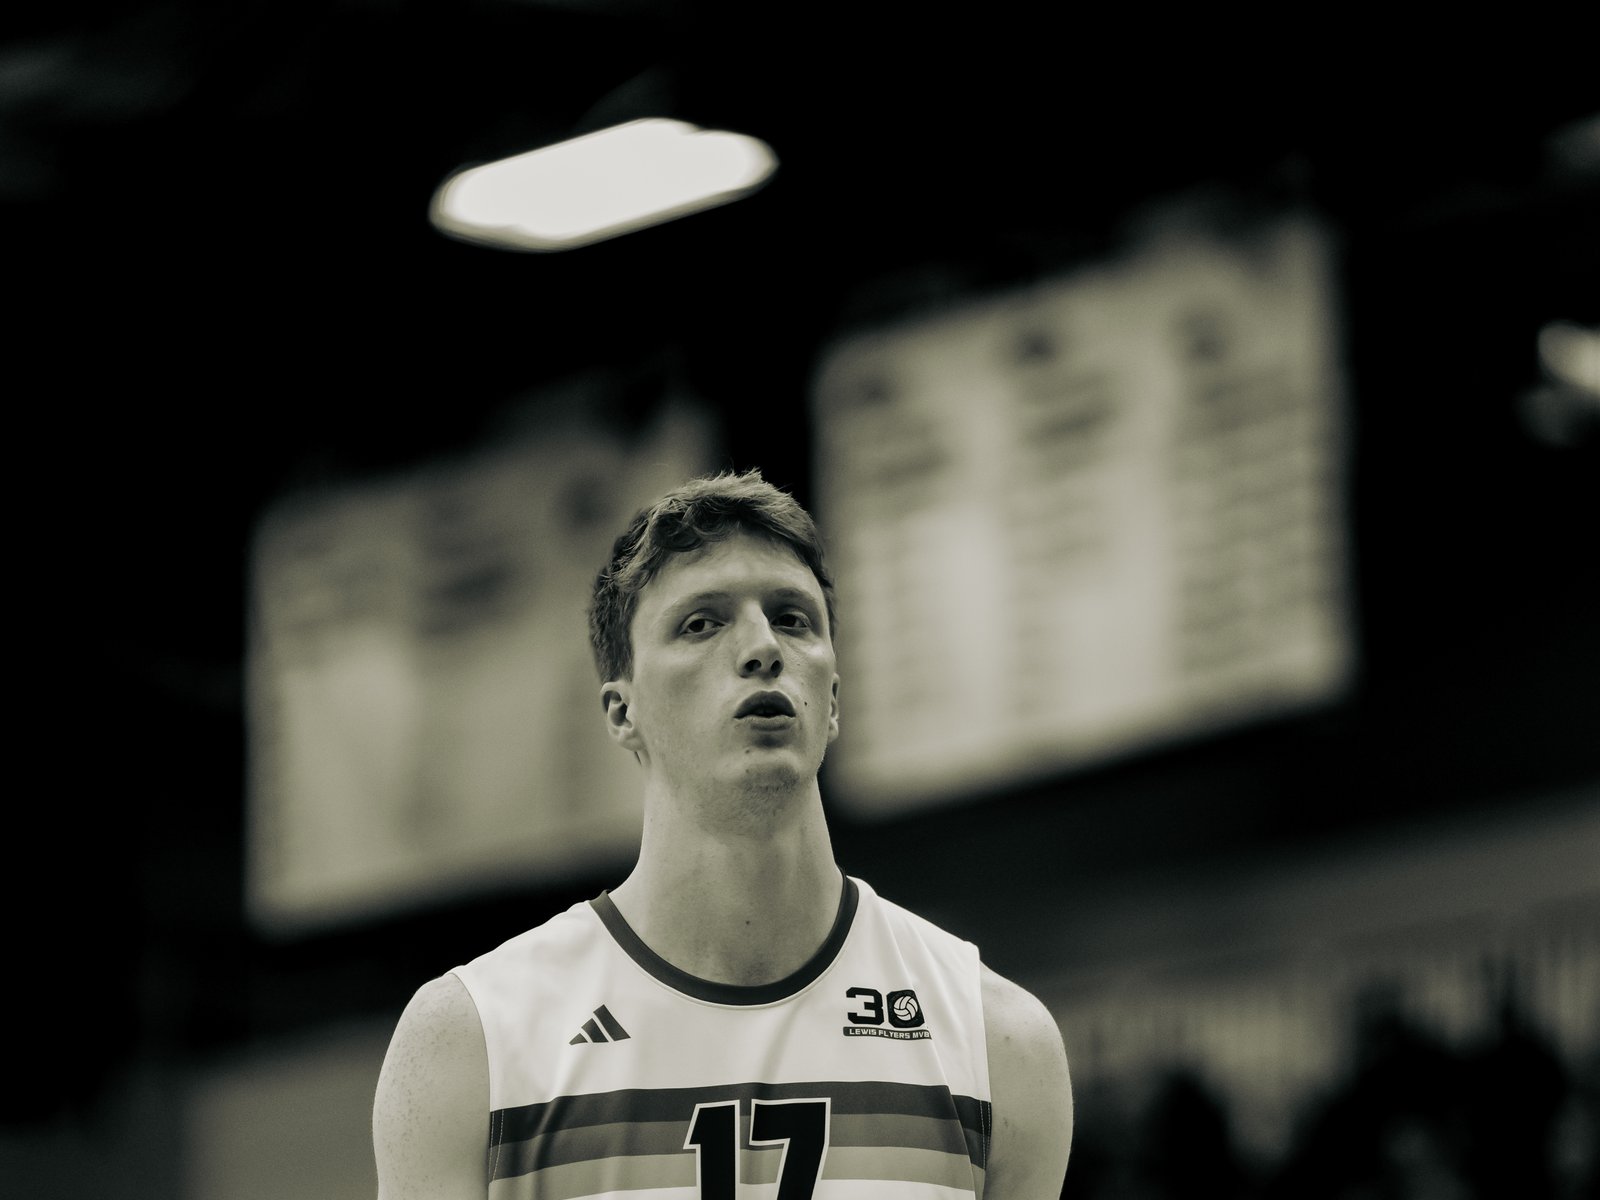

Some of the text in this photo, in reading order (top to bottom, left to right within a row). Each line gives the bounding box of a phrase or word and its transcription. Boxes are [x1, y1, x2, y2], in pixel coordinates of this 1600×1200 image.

[846, 987, 925, 1028] 30
[849, 1028, 930, 1039] LEWIS FLYERS MVB
